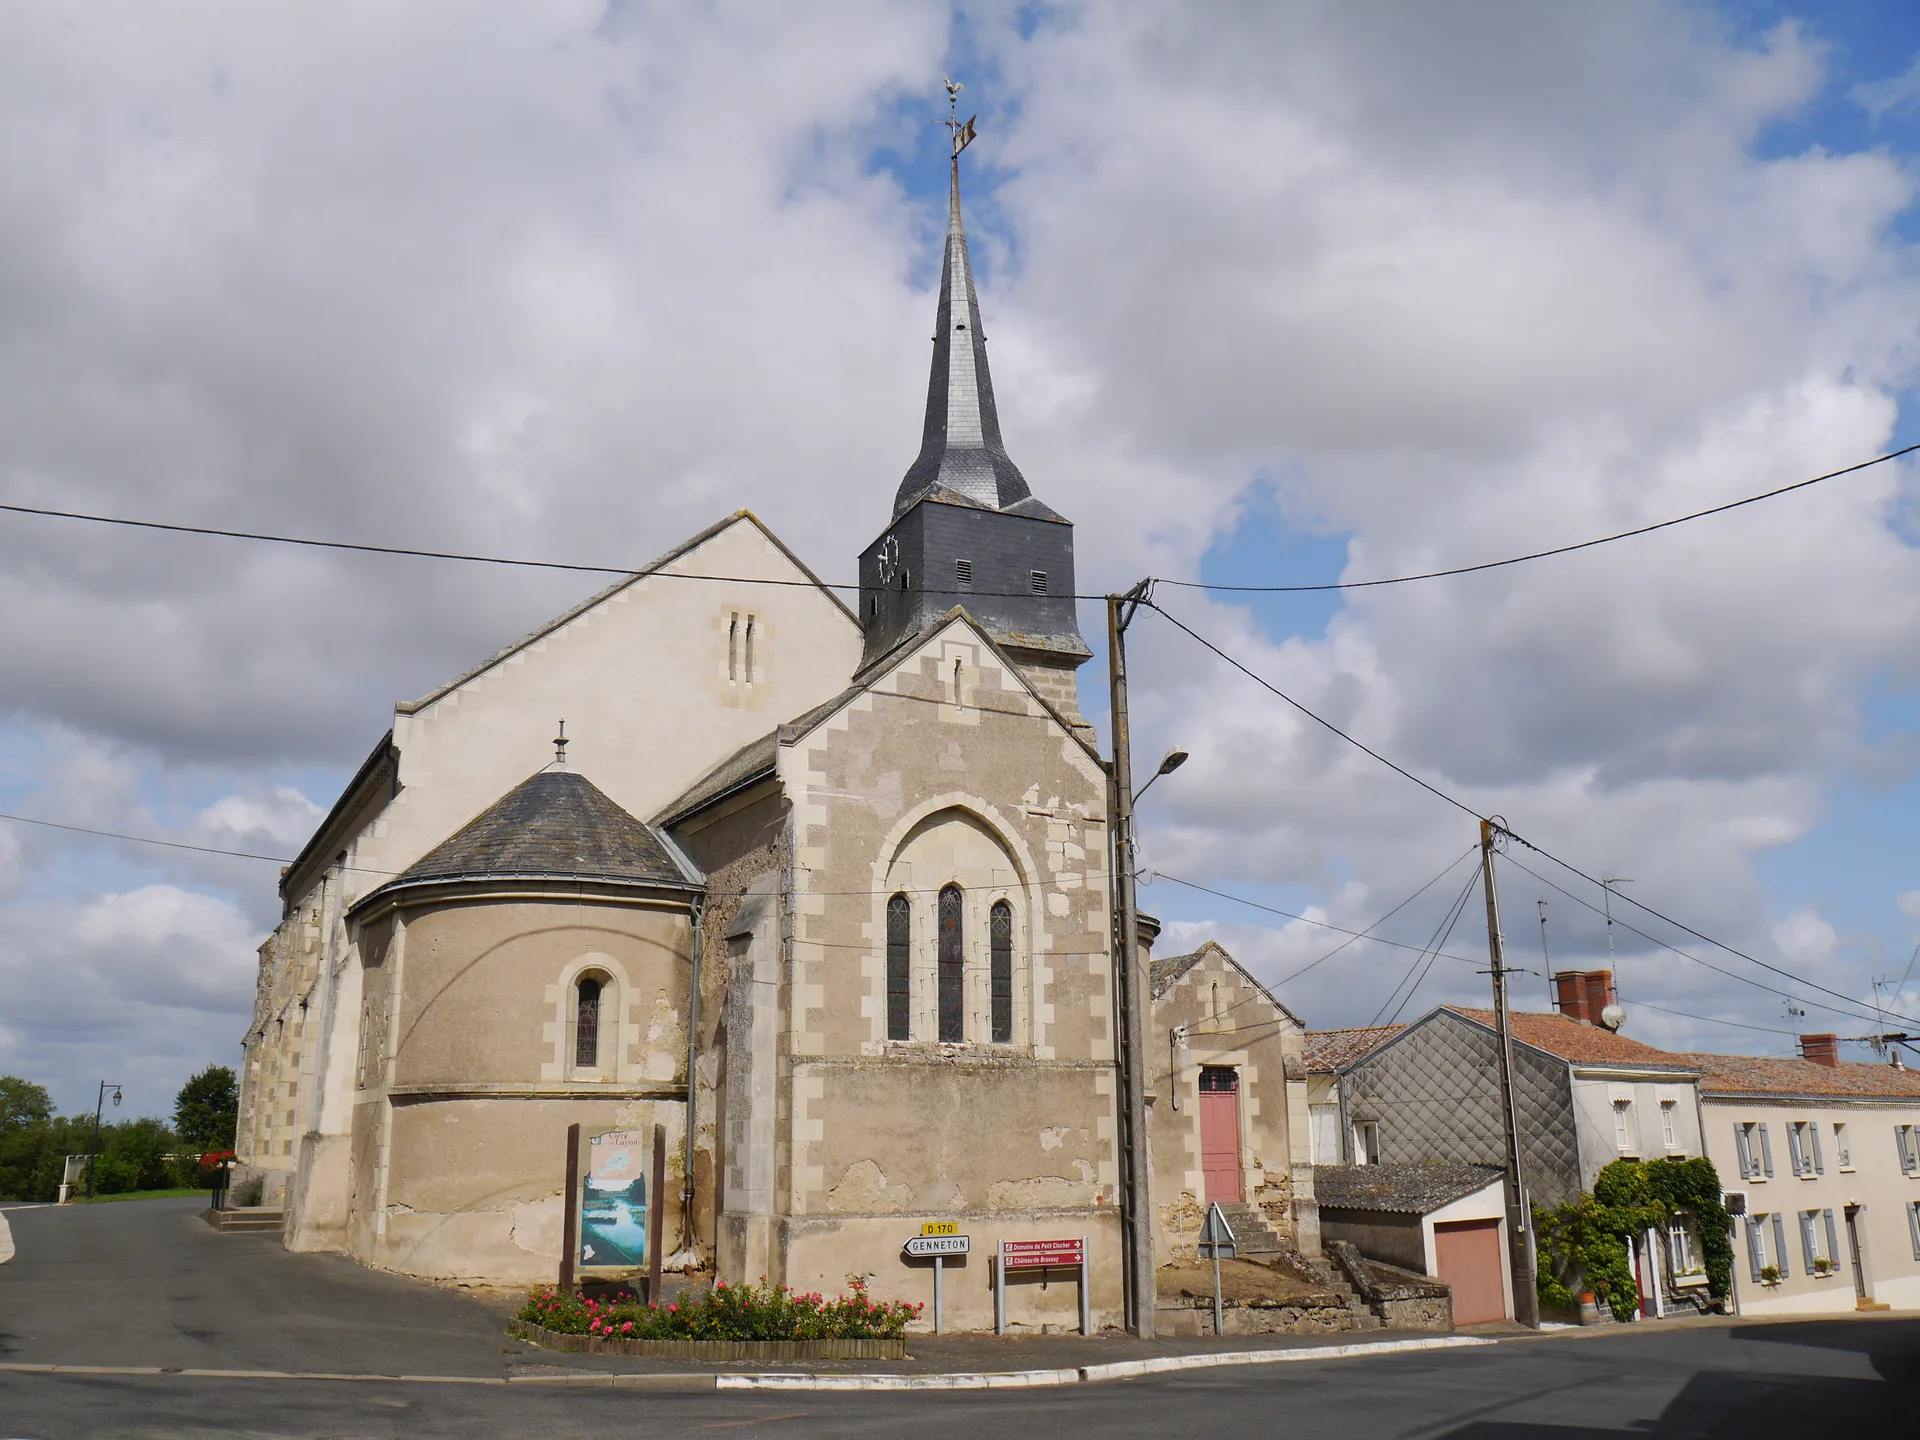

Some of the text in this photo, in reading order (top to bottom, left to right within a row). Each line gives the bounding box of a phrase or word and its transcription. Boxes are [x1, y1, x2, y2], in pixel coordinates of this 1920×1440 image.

[615, 1138, 638, 1147] Layon
[927, 1224, 953, 1234] D 170
[912, 1240, 966, 1251] GENNETON
